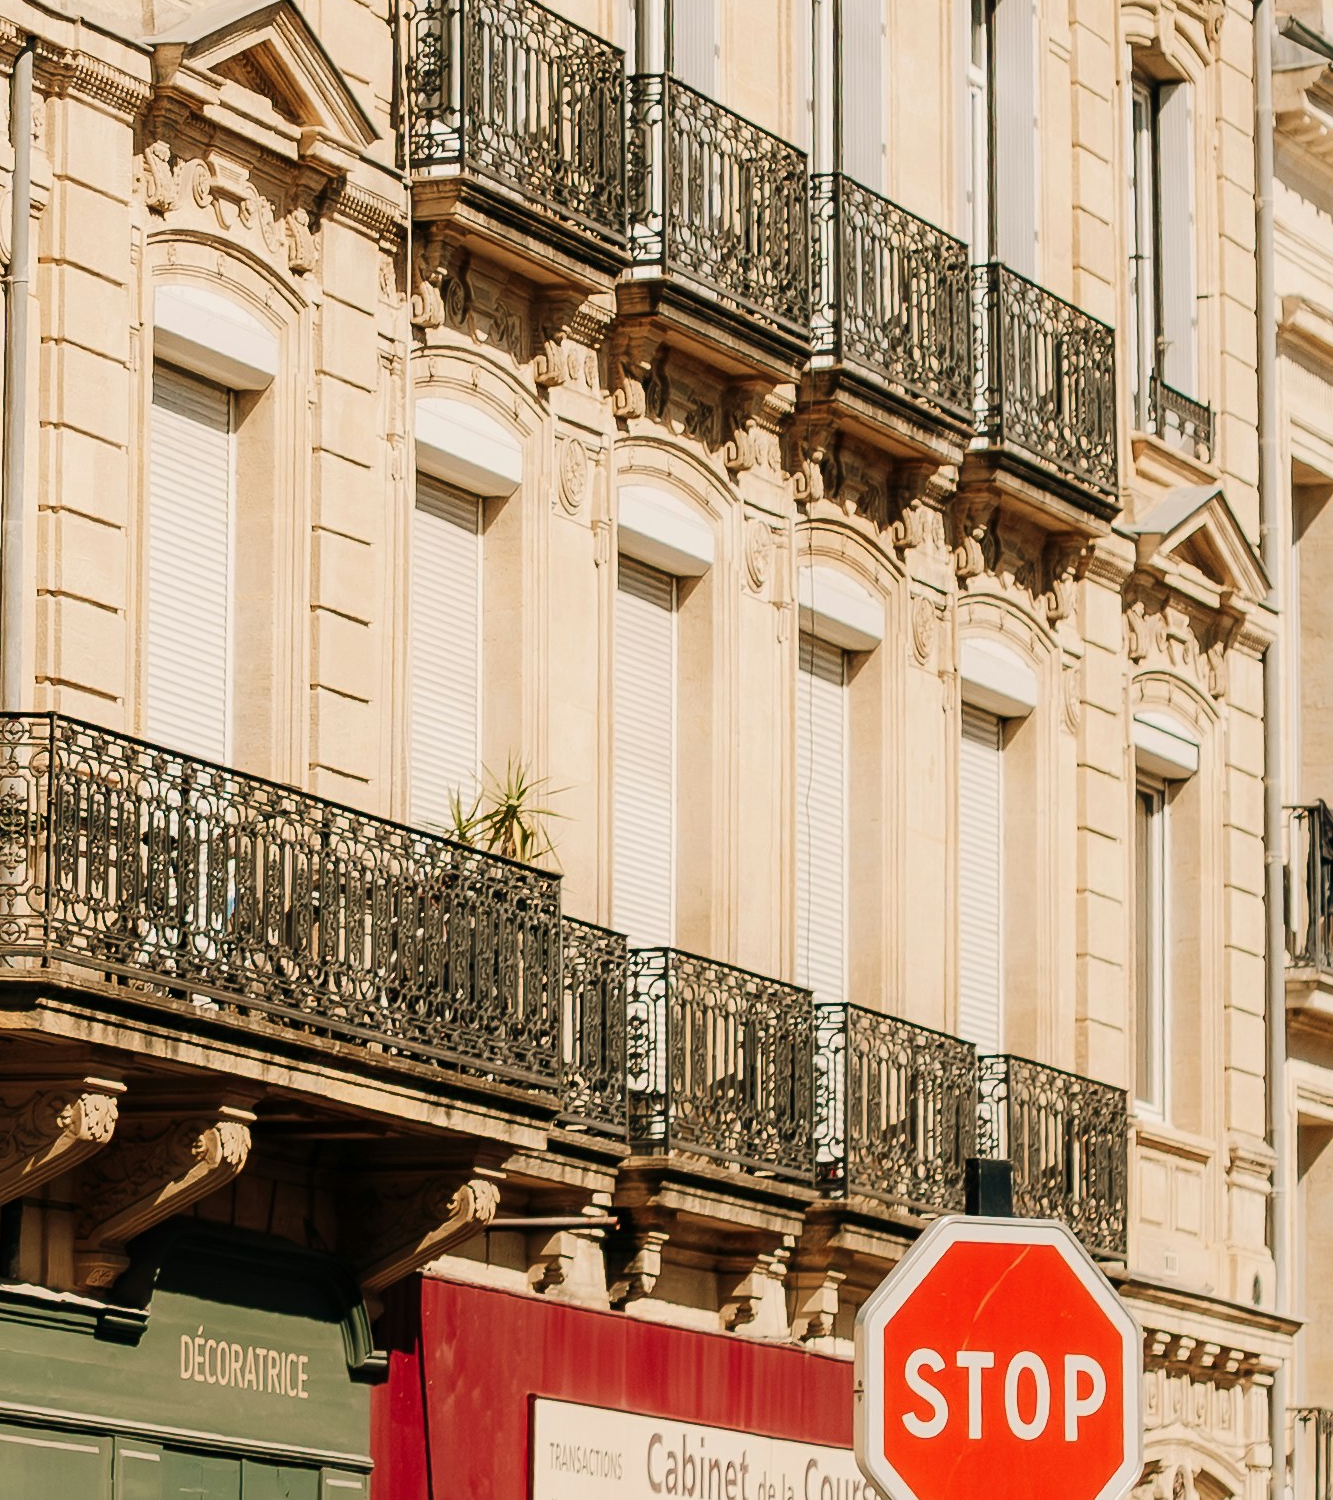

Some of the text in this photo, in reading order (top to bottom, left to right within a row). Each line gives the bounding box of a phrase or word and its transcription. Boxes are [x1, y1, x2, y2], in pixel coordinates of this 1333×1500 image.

[180, 1325, 309, 1399] DÉCORATRICE
[901, 1347, 1107, 1442] STOP
[550, 1442, 622, 1480] TRANSACTIONS
